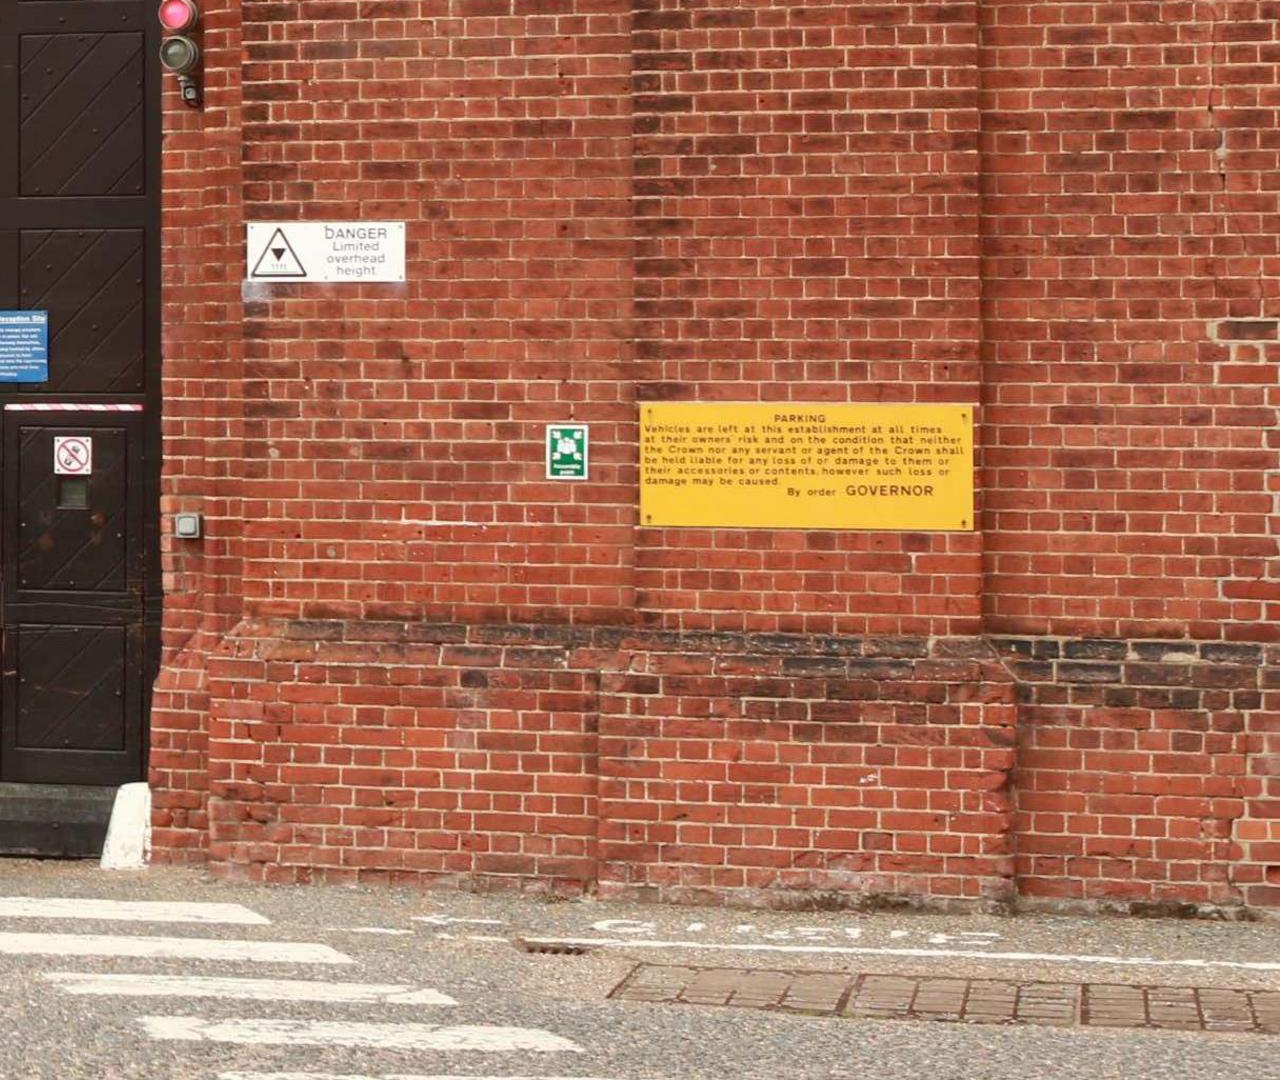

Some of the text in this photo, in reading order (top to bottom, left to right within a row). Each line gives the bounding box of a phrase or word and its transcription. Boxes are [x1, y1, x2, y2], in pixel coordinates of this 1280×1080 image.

[325, 228, 387, 239] DANGER
[332, 241, 379, 251] Limited
[327, 253, 385, 264] overhead
[337, 265, 376, 277] height
[774, 414, 826, 423] PARKING
[645, 424, 690, 433] Vehicles
[718, 425, 738, 433] left
[788, 425, 865, 434] establishment
[872, 426, 882, 434] at
[889, 425, 904, 434] all
[911, 425, 942, 434] times
[765, 436, 784, 444] and
[808, 436, 827, 444] the
[832, 436, 884, 444] condition
[890, 436, 913, 444] that
[920, 436, 962, 444] neither
[645, 446, 662, 454] the
[668, 446, 704, 454] Crown
[732, 448, 750, 456] any
[756, 447, 797, 455] servant
[817, 447, 848, 456] agent
[852, 446, 863, 454] of
[869, 447, 888, 455] the
[895, 446, 931, 455] Crown
[936, 446, 964, 455] shall
[645, 456, 657, 464] be
[662, 456, 686, 464] held
[690, 456, 722, 464] liable
[749, 458, 768, 466] any
[772, 457, 796, 465] loss
[801, 457, 812, 465] of
[835, 457, 879, 466] damage
[822, 468, 869, 476] however
[876, 468, 902, 476] such
[908, 468, 932, 476] loss
[645, 477, 688, 486] damage
[720, 477, 733, 485] be
[787, 485, 934, 497] By order GOVERNOR
